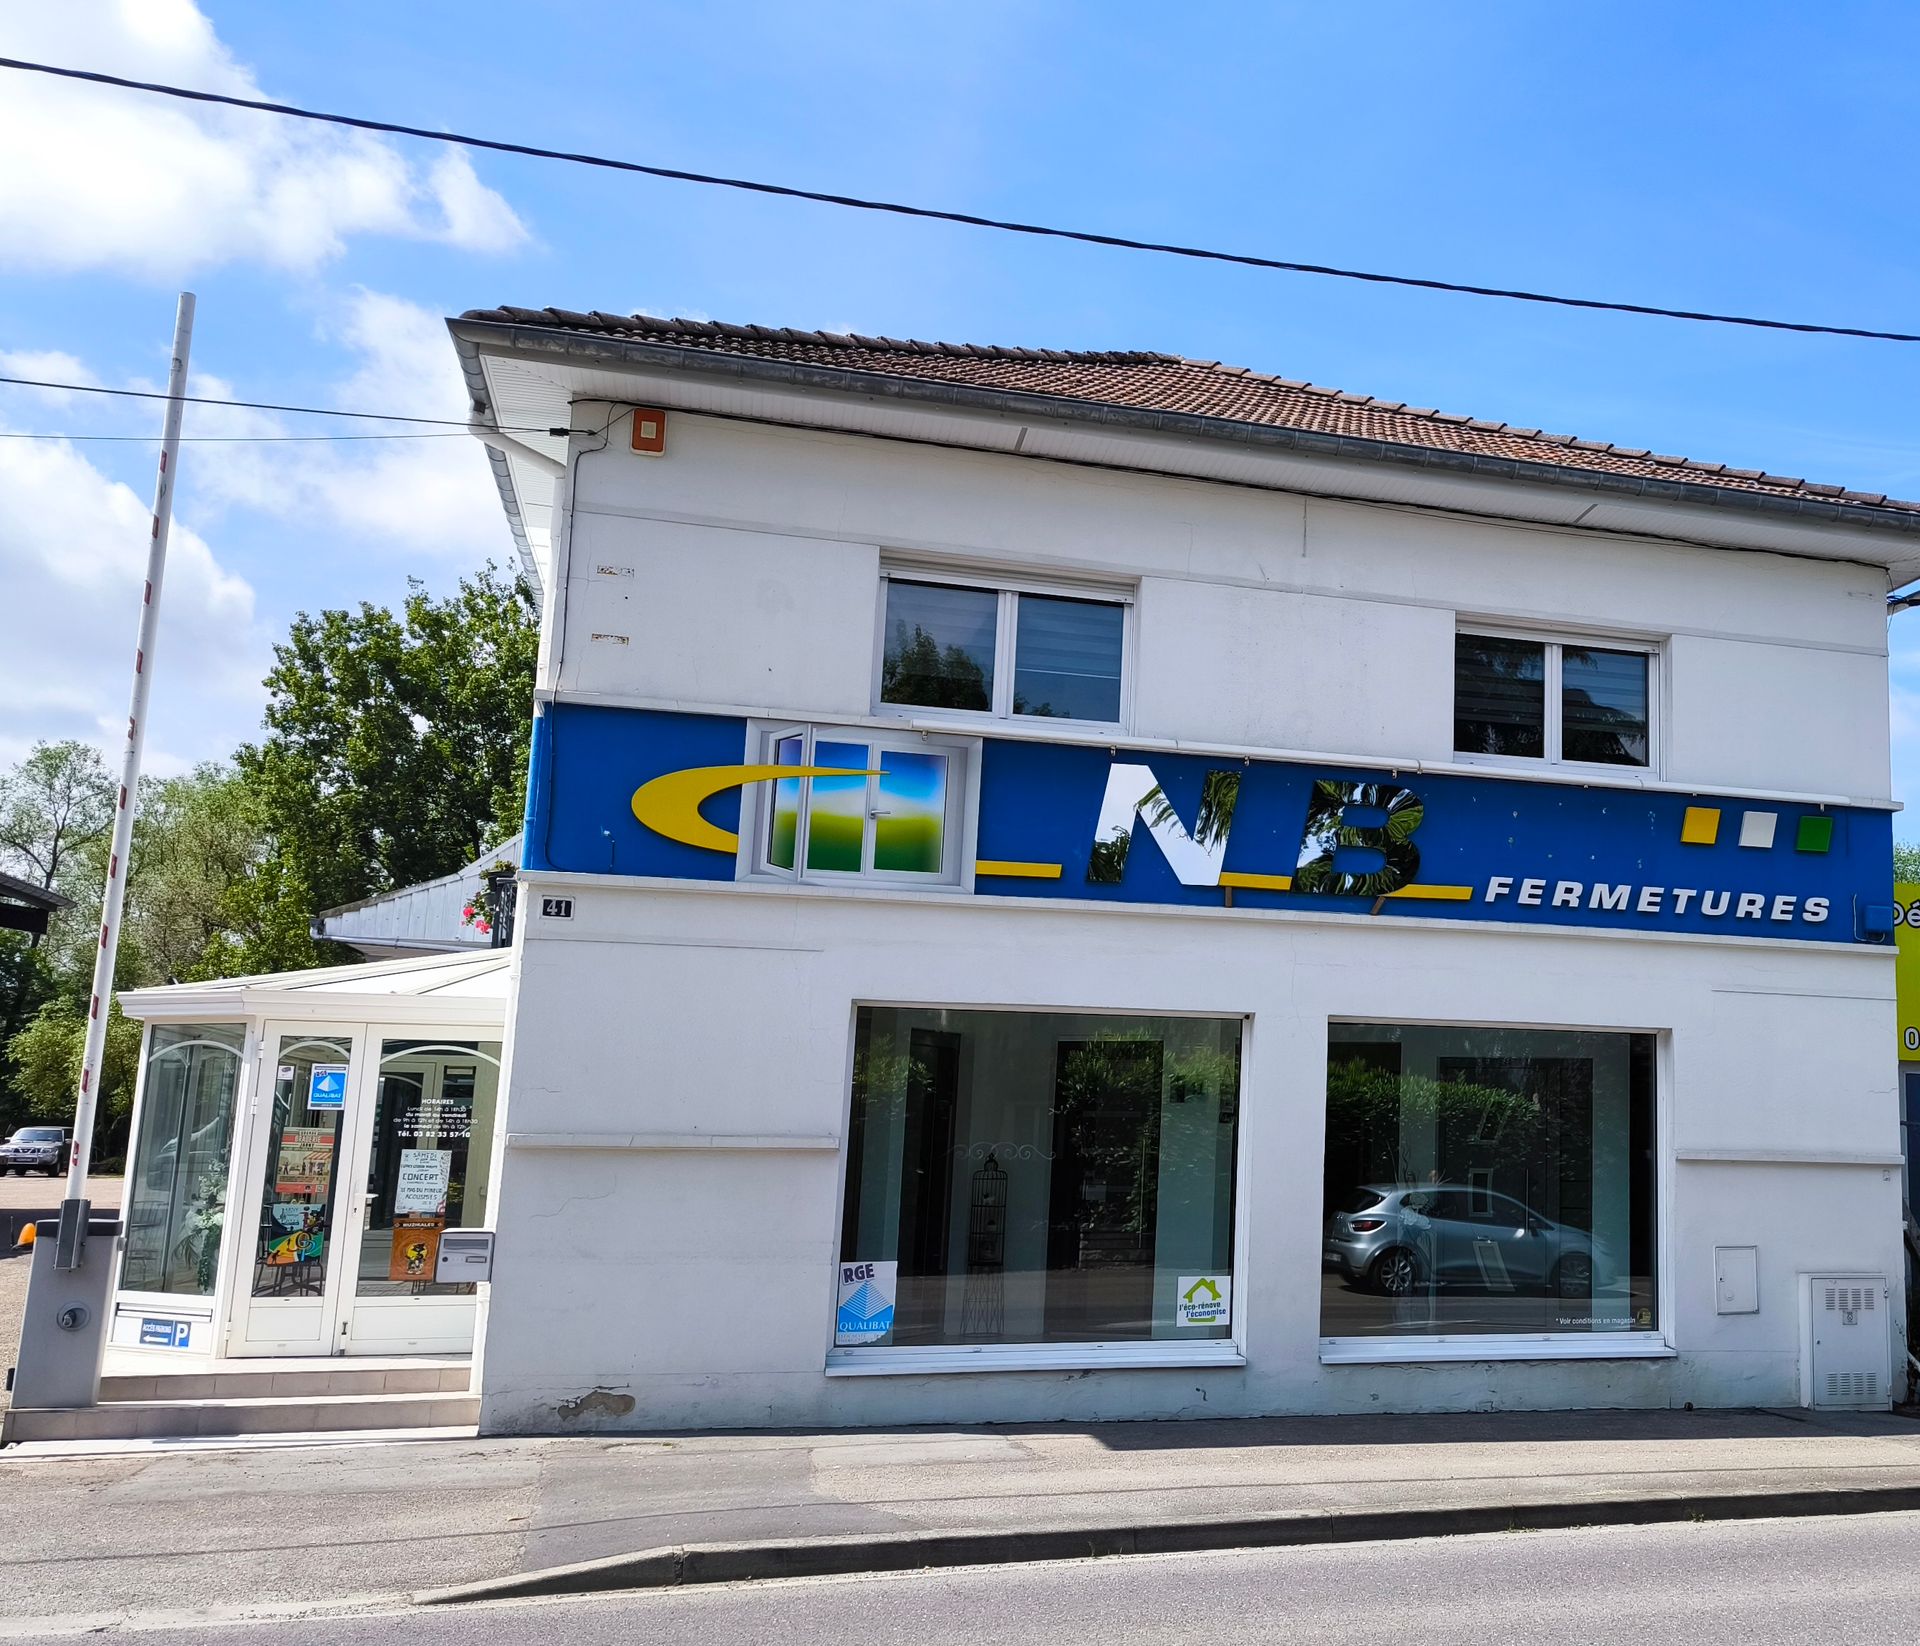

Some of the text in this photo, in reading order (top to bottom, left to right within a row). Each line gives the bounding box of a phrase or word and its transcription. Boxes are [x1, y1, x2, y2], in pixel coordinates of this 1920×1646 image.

[1484, 876, 1830, 922] FERMETURES
[546, 900, 566, 916] 41
[1904, 1027, 1920, 1050] 0
[402, 1173, 439, 1181] CONCERT
[843, 1263, 875, 1284] RGE
[839, 1320, 892, 1332] QUALIBAT
[1572, 1317, 1602, 1325] conditions
[1611, 1317, 1636, 1325] magasin
